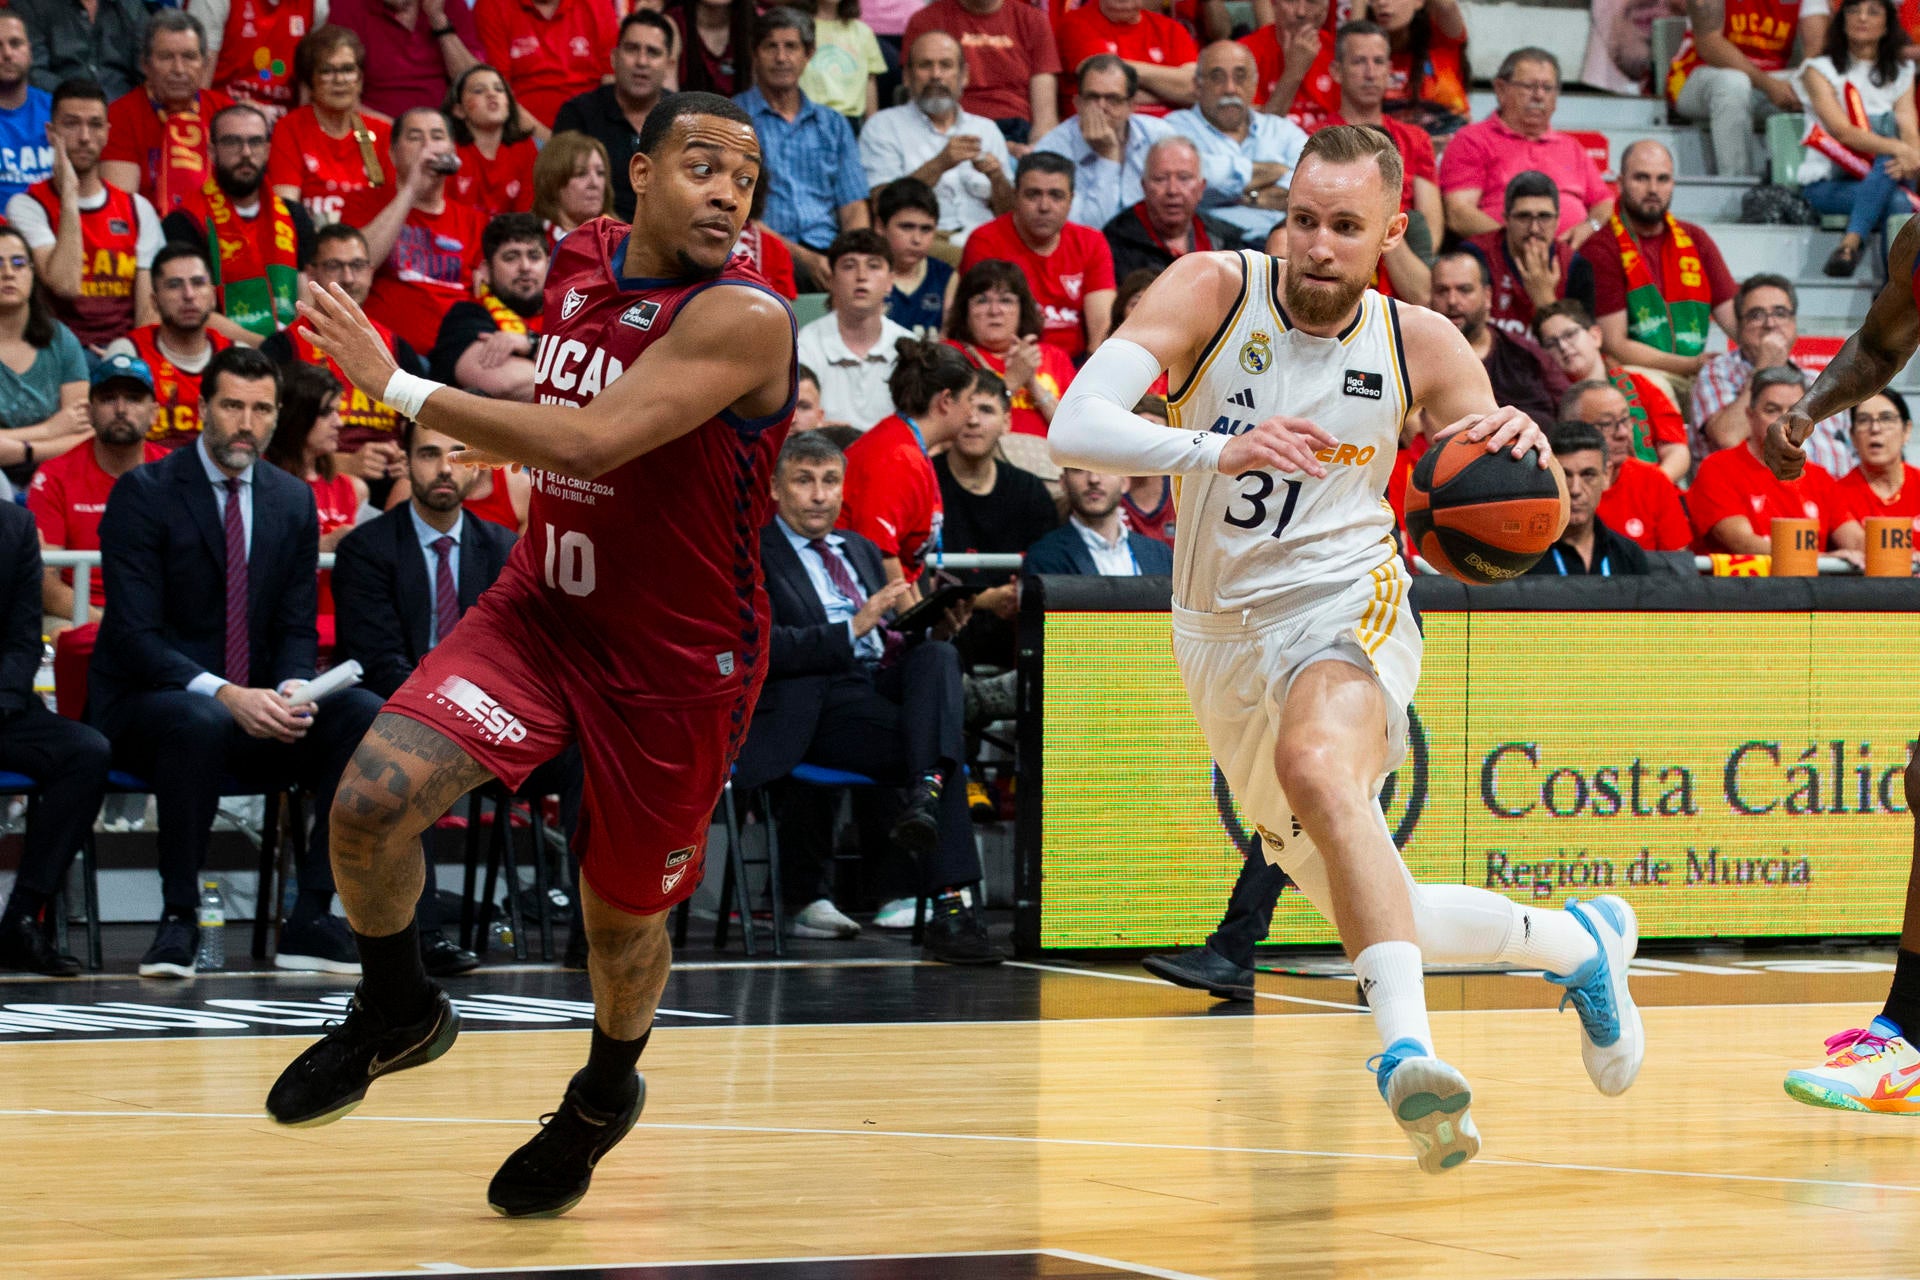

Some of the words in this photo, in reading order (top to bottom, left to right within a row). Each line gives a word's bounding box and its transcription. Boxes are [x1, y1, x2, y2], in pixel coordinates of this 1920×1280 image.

[1346, 385, 1380, 397] endesa
[1347, 376, 1363, 387] liga
[545, 484, 561, 497] AÑO
[562, 488, 596, 506] JUBILAR
[546, 471, 556, 482] DE
[556, 474, 566, 486] LA
[567, 477, 592, 492] CRUZ
[592, 483, 615, 497] 2024
[1224, 470, 1303, 539] 31
[1795, 530, 1817, 550] IR
[545, 523, 596, 597] 10
[473, 697, 528, 743] ESP
[1480, 741, 1698, 818] Costa
[1485, 847, 1614, 898] Región
[1626, 848, 1672, 887] de
[1686, 846, 1812, 887] Murcia
